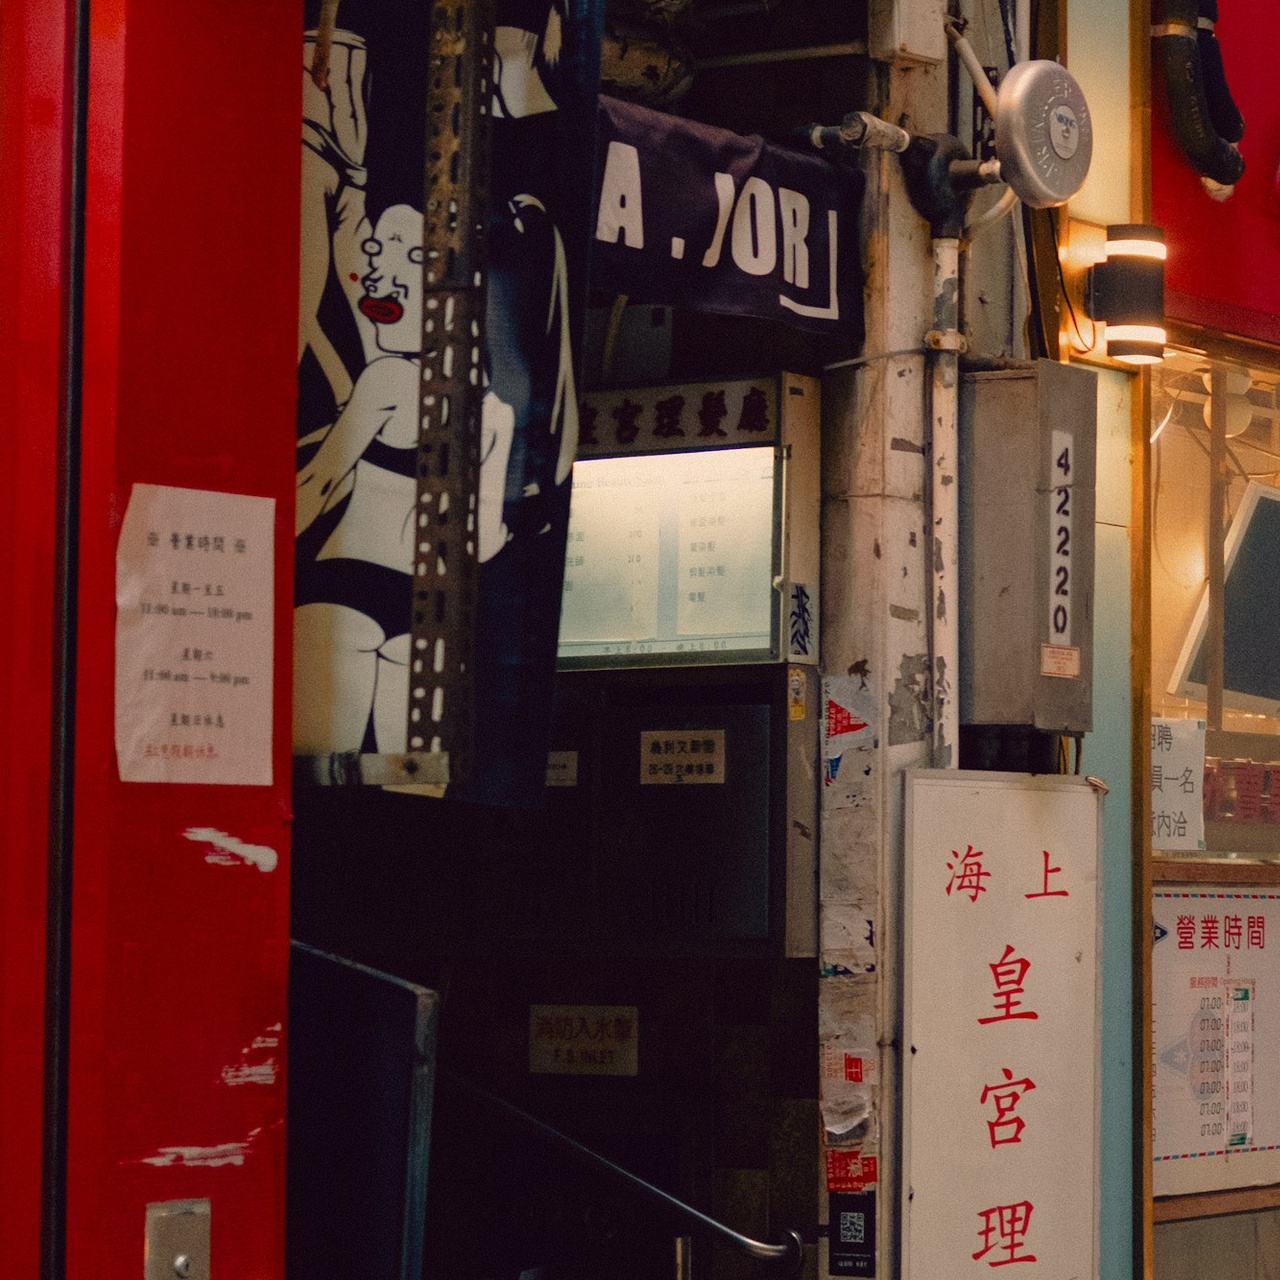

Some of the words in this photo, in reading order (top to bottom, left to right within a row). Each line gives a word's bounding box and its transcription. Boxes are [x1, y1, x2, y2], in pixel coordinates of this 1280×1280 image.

[1053, 446, 1071, 636] 42220
[1176, 914, 1265, 950] 營業時間
